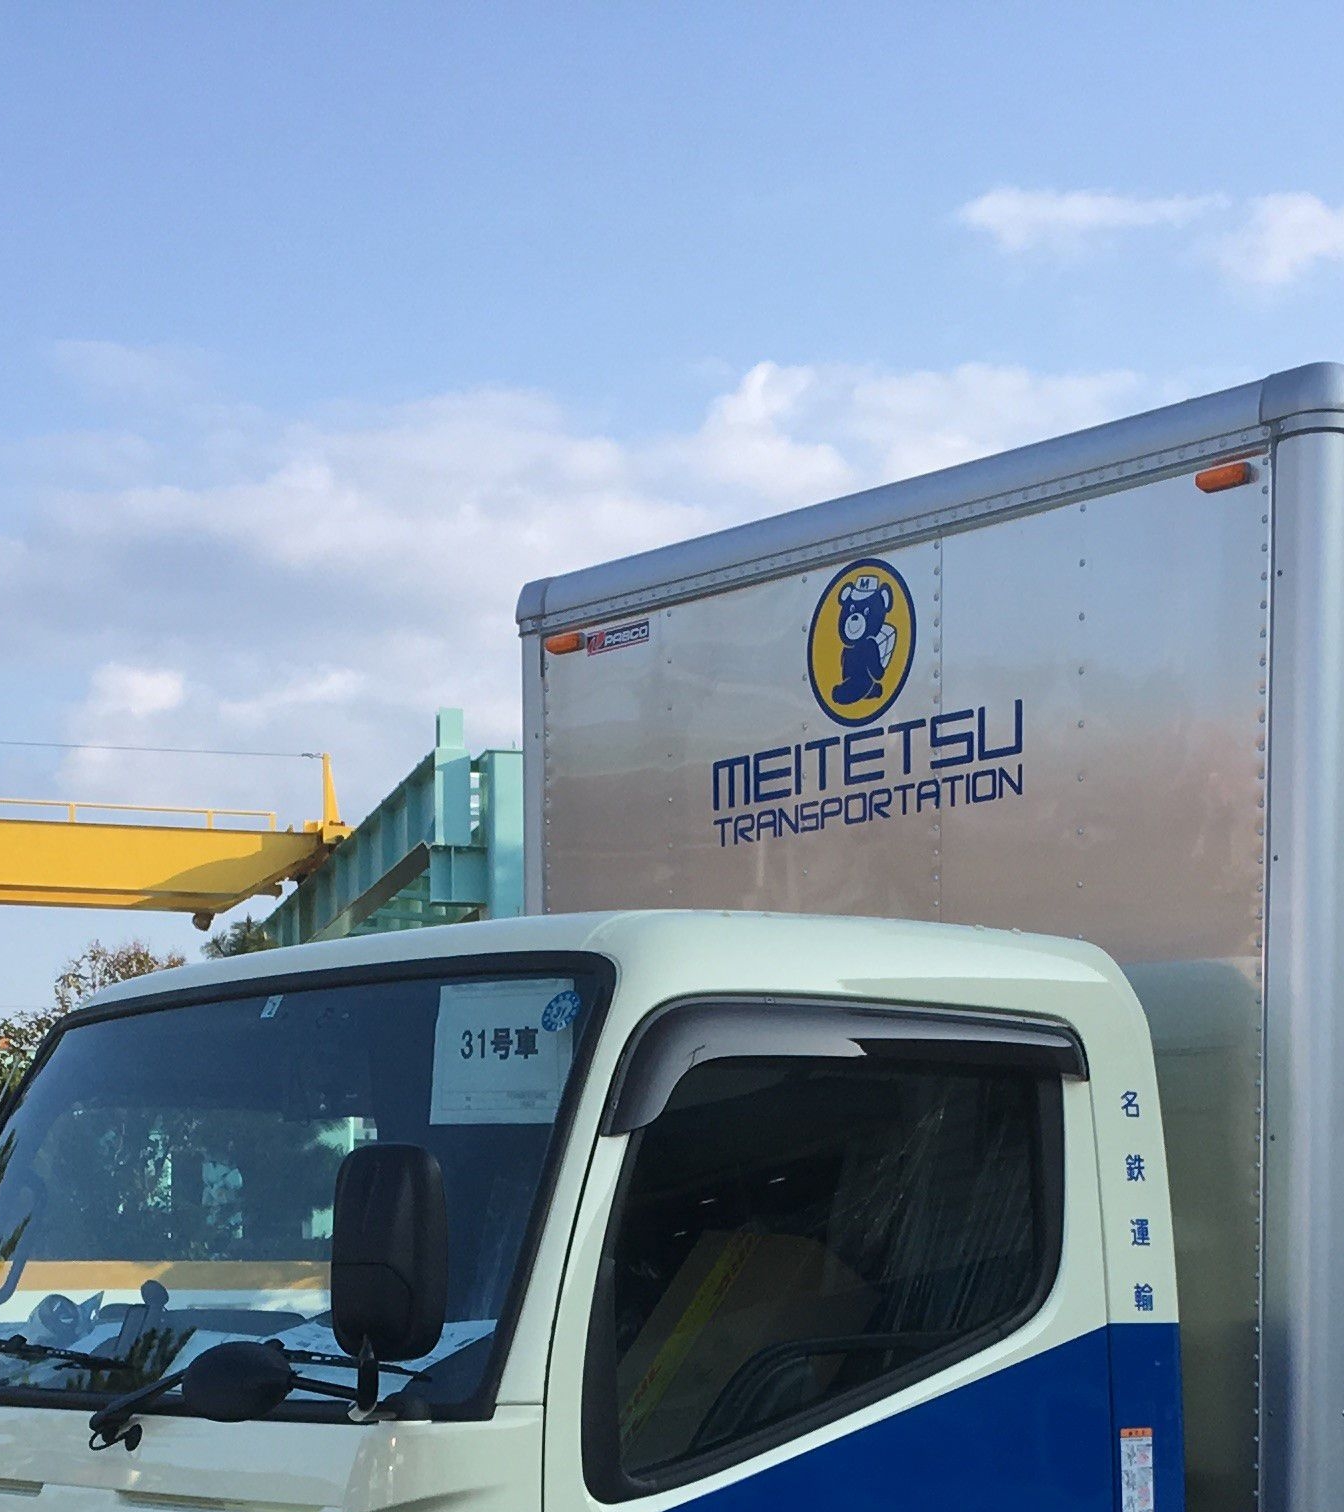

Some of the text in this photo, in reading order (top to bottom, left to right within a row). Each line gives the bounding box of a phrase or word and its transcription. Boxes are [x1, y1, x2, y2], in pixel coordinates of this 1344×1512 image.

[713, 699, 1023, 811] MEITETSU
[713, 763, 1023, 847] TRANSPORTATION
[460, 1026, 538, 1060] 31号車
[1120, 1090, 1153, 1311] 名鉄運輸
